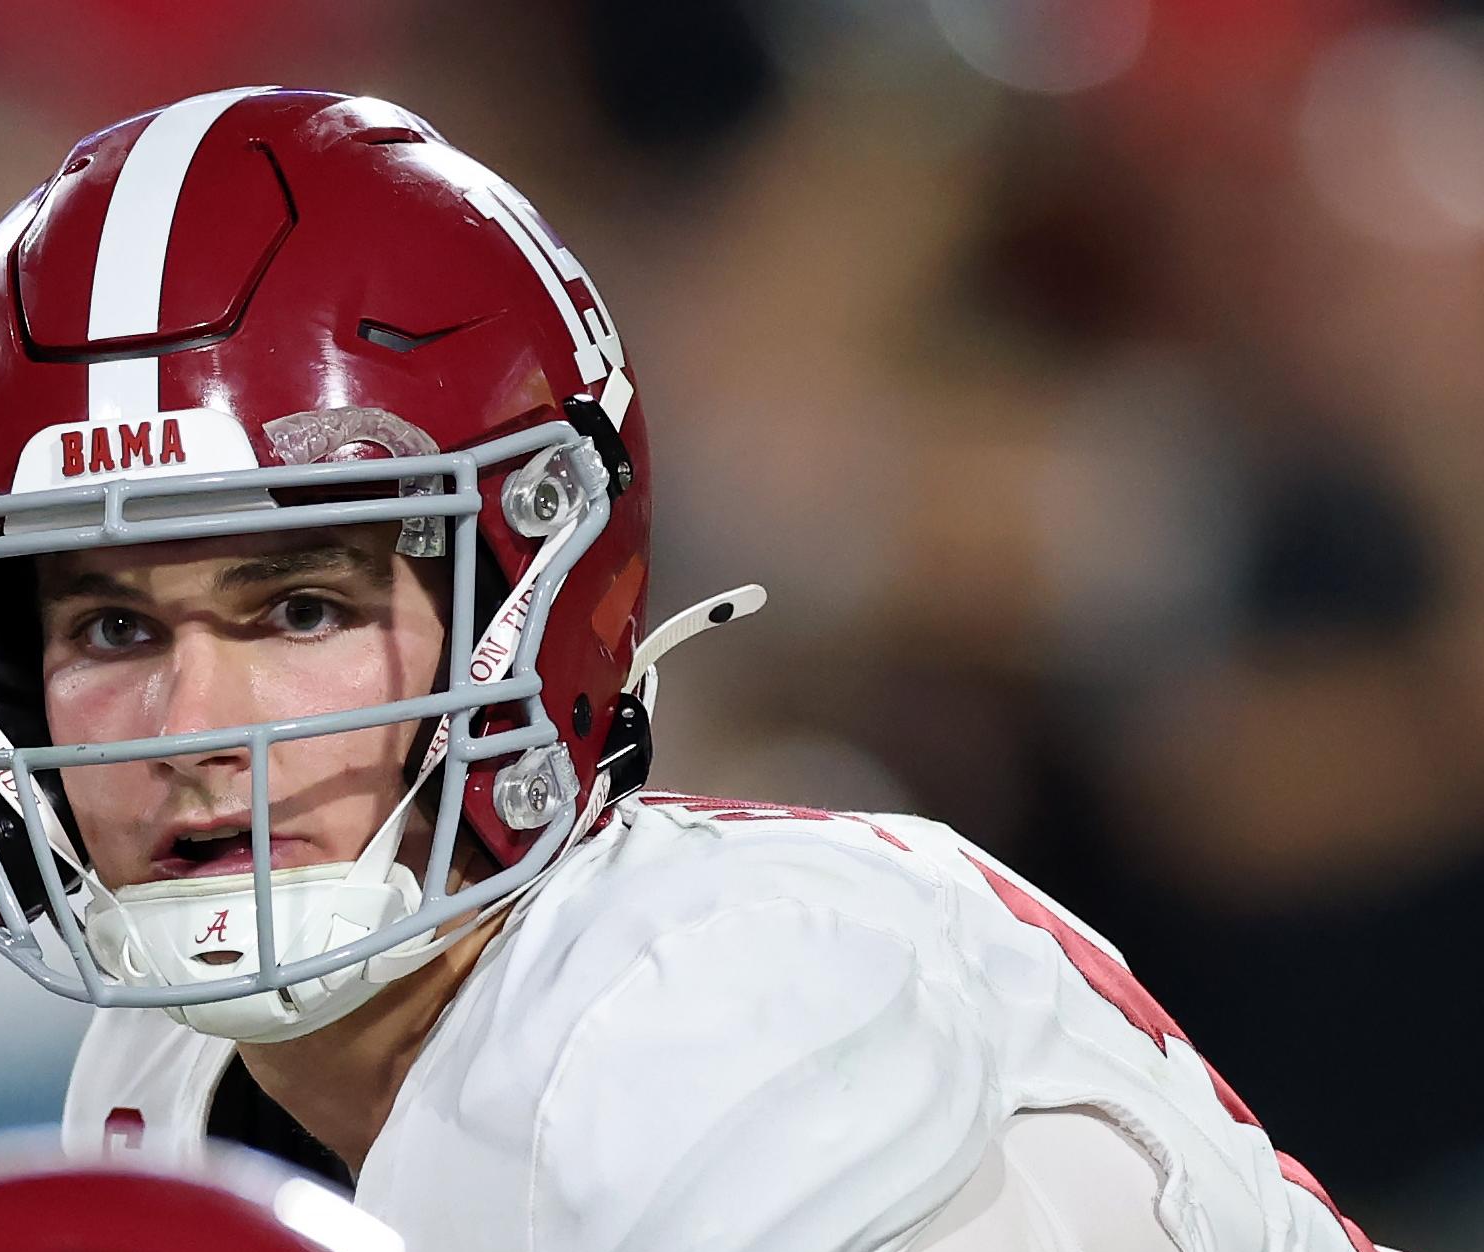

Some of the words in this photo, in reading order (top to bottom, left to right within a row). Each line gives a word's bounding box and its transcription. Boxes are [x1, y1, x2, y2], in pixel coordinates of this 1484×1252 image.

[463, 179, 626, 385] 15
[61, 418, 186, 477] BAMA
[195, 909, 229, 944] A
